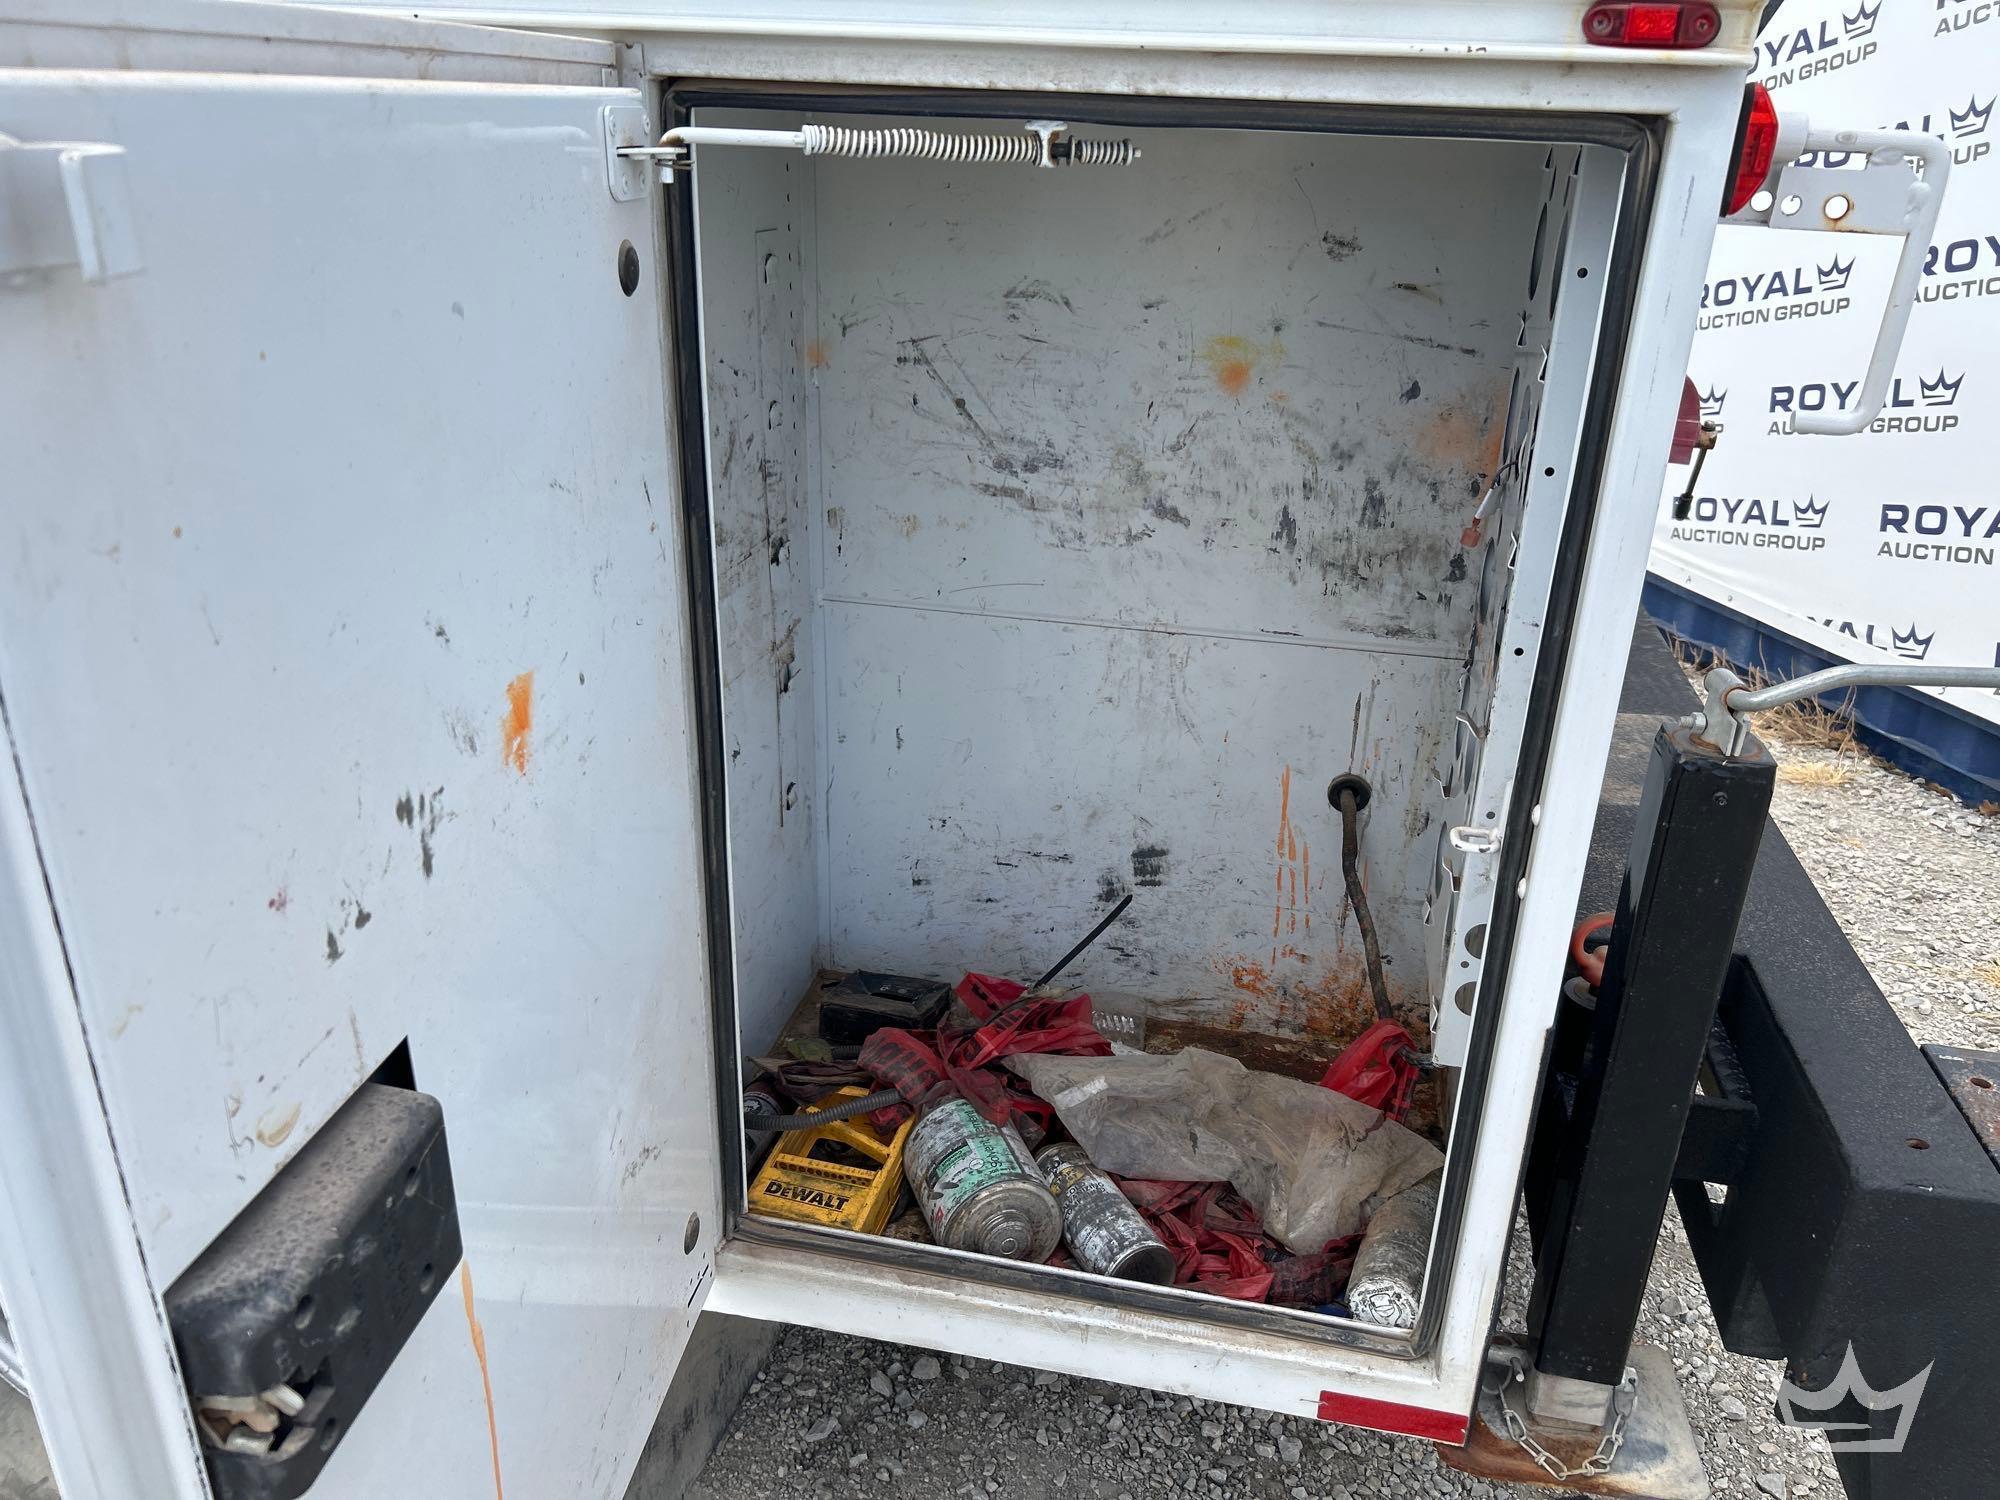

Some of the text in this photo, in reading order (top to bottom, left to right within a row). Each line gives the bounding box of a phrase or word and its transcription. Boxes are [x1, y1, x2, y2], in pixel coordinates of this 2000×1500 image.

[1798, 41, 1877, 81] GROUP
[1695, 297, 1851, 331] UCTION GROUP
[1769, 378, 1915, 413] ROYL
[1869, 415, 1959, 434] GROUP
[1670, 527, 1826, 551] AUCTION GROUP
[1877, 541, 1995, 566] AUCTION
